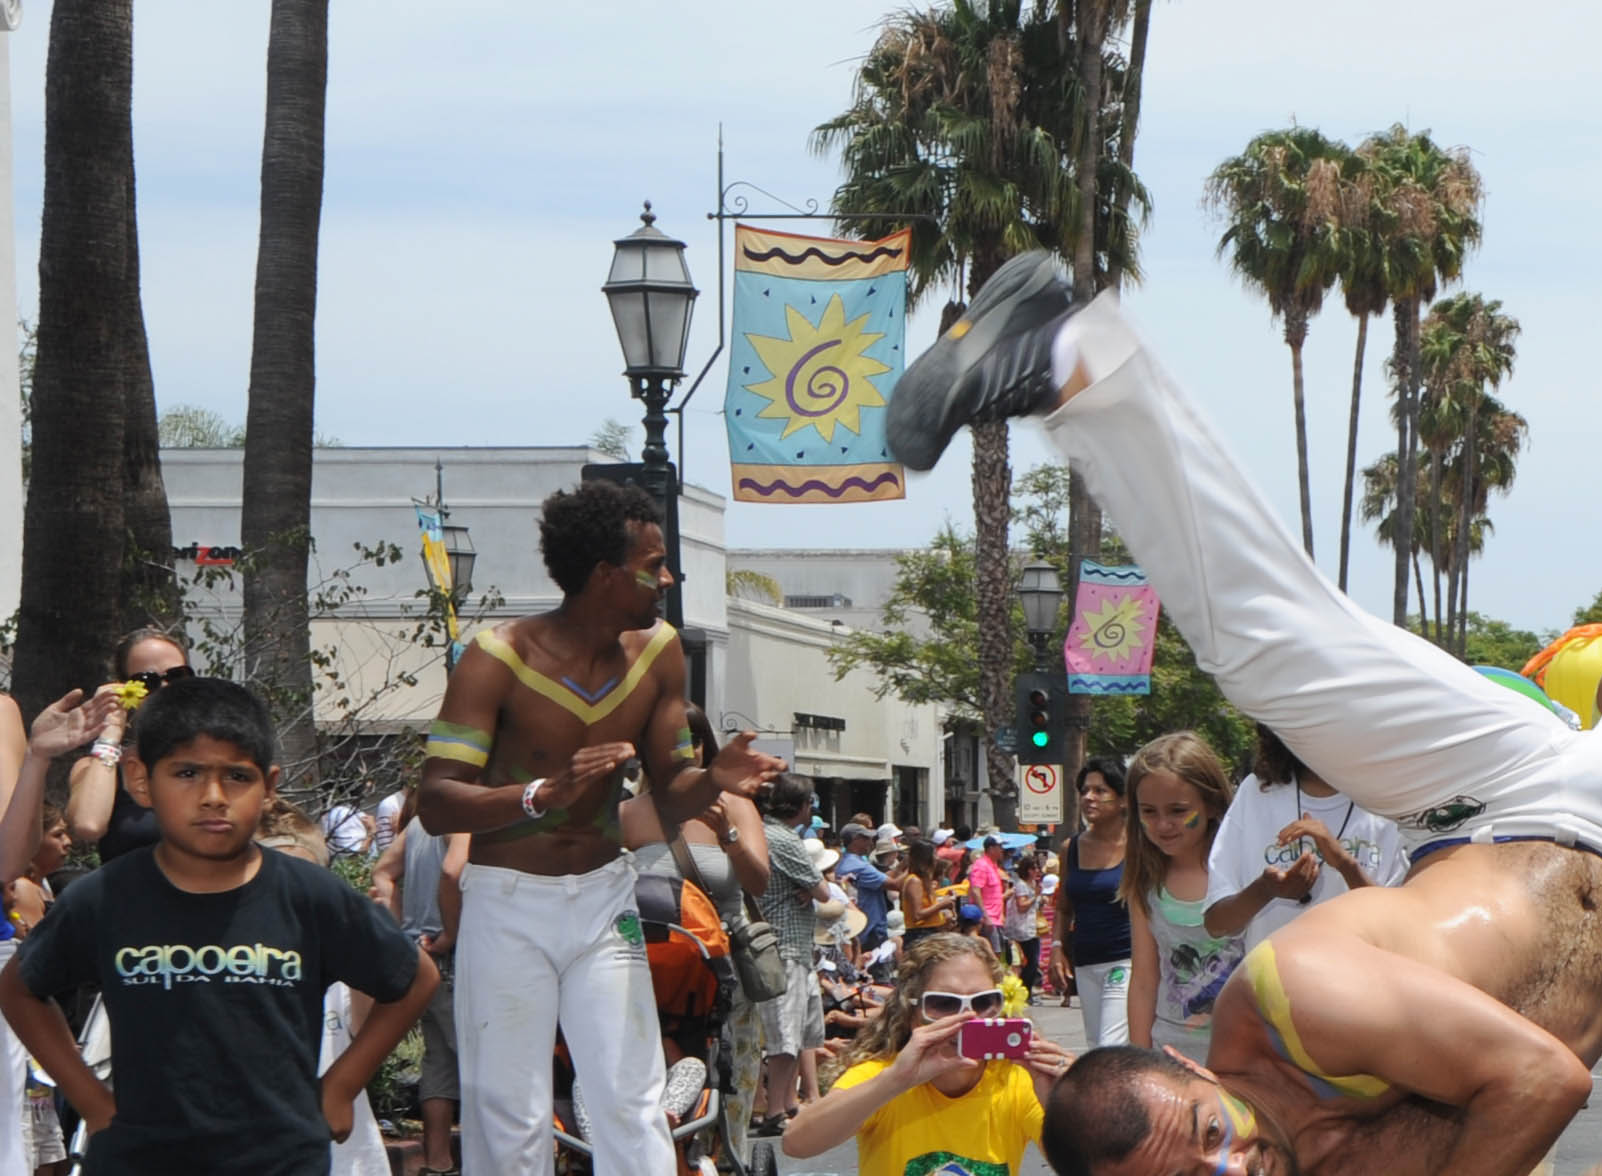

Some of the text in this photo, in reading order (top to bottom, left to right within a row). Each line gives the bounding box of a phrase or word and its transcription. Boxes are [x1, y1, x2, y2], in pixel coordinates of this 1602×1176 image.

[170, 541, 238, 565] erizon
[114, 943, 302, 990] capoeira
[175, 974, 211, 983] DA
